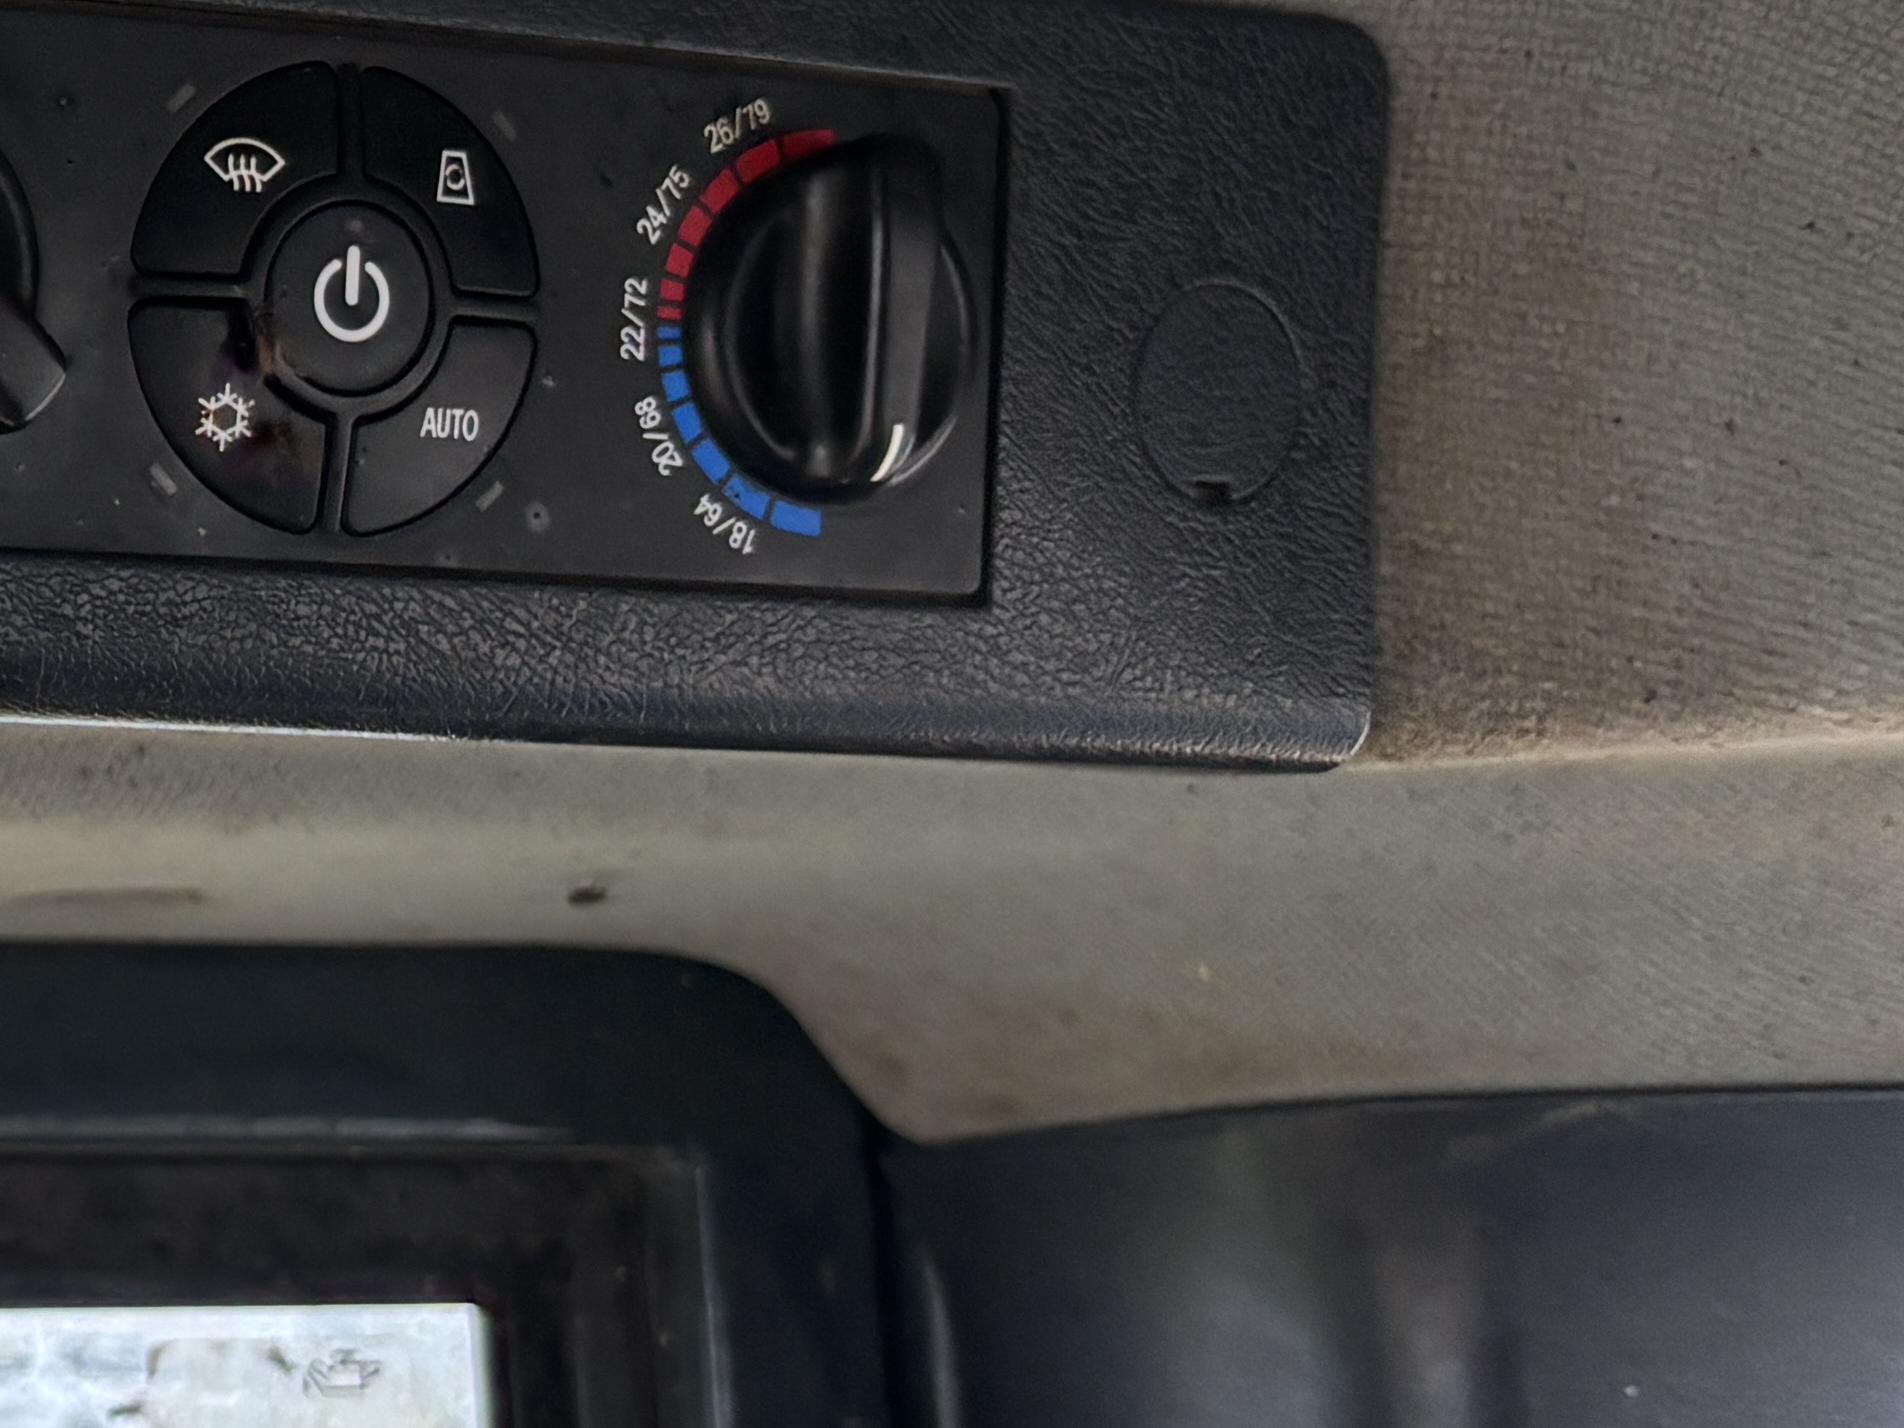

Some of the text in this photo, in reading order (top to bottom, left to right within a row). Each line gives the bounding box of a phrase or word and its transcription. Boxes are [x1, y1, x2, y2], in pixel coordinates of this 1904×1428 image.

[702, 97, 772, 155] 26/79
[635, 164, 691, 246] 24/75
[618, 276, 649, 363] 22/72
[418, 406, 481, 443] AUTO
[633, 395, 685, 477] 20/68
[692, 492, 757, 556] 18/64
